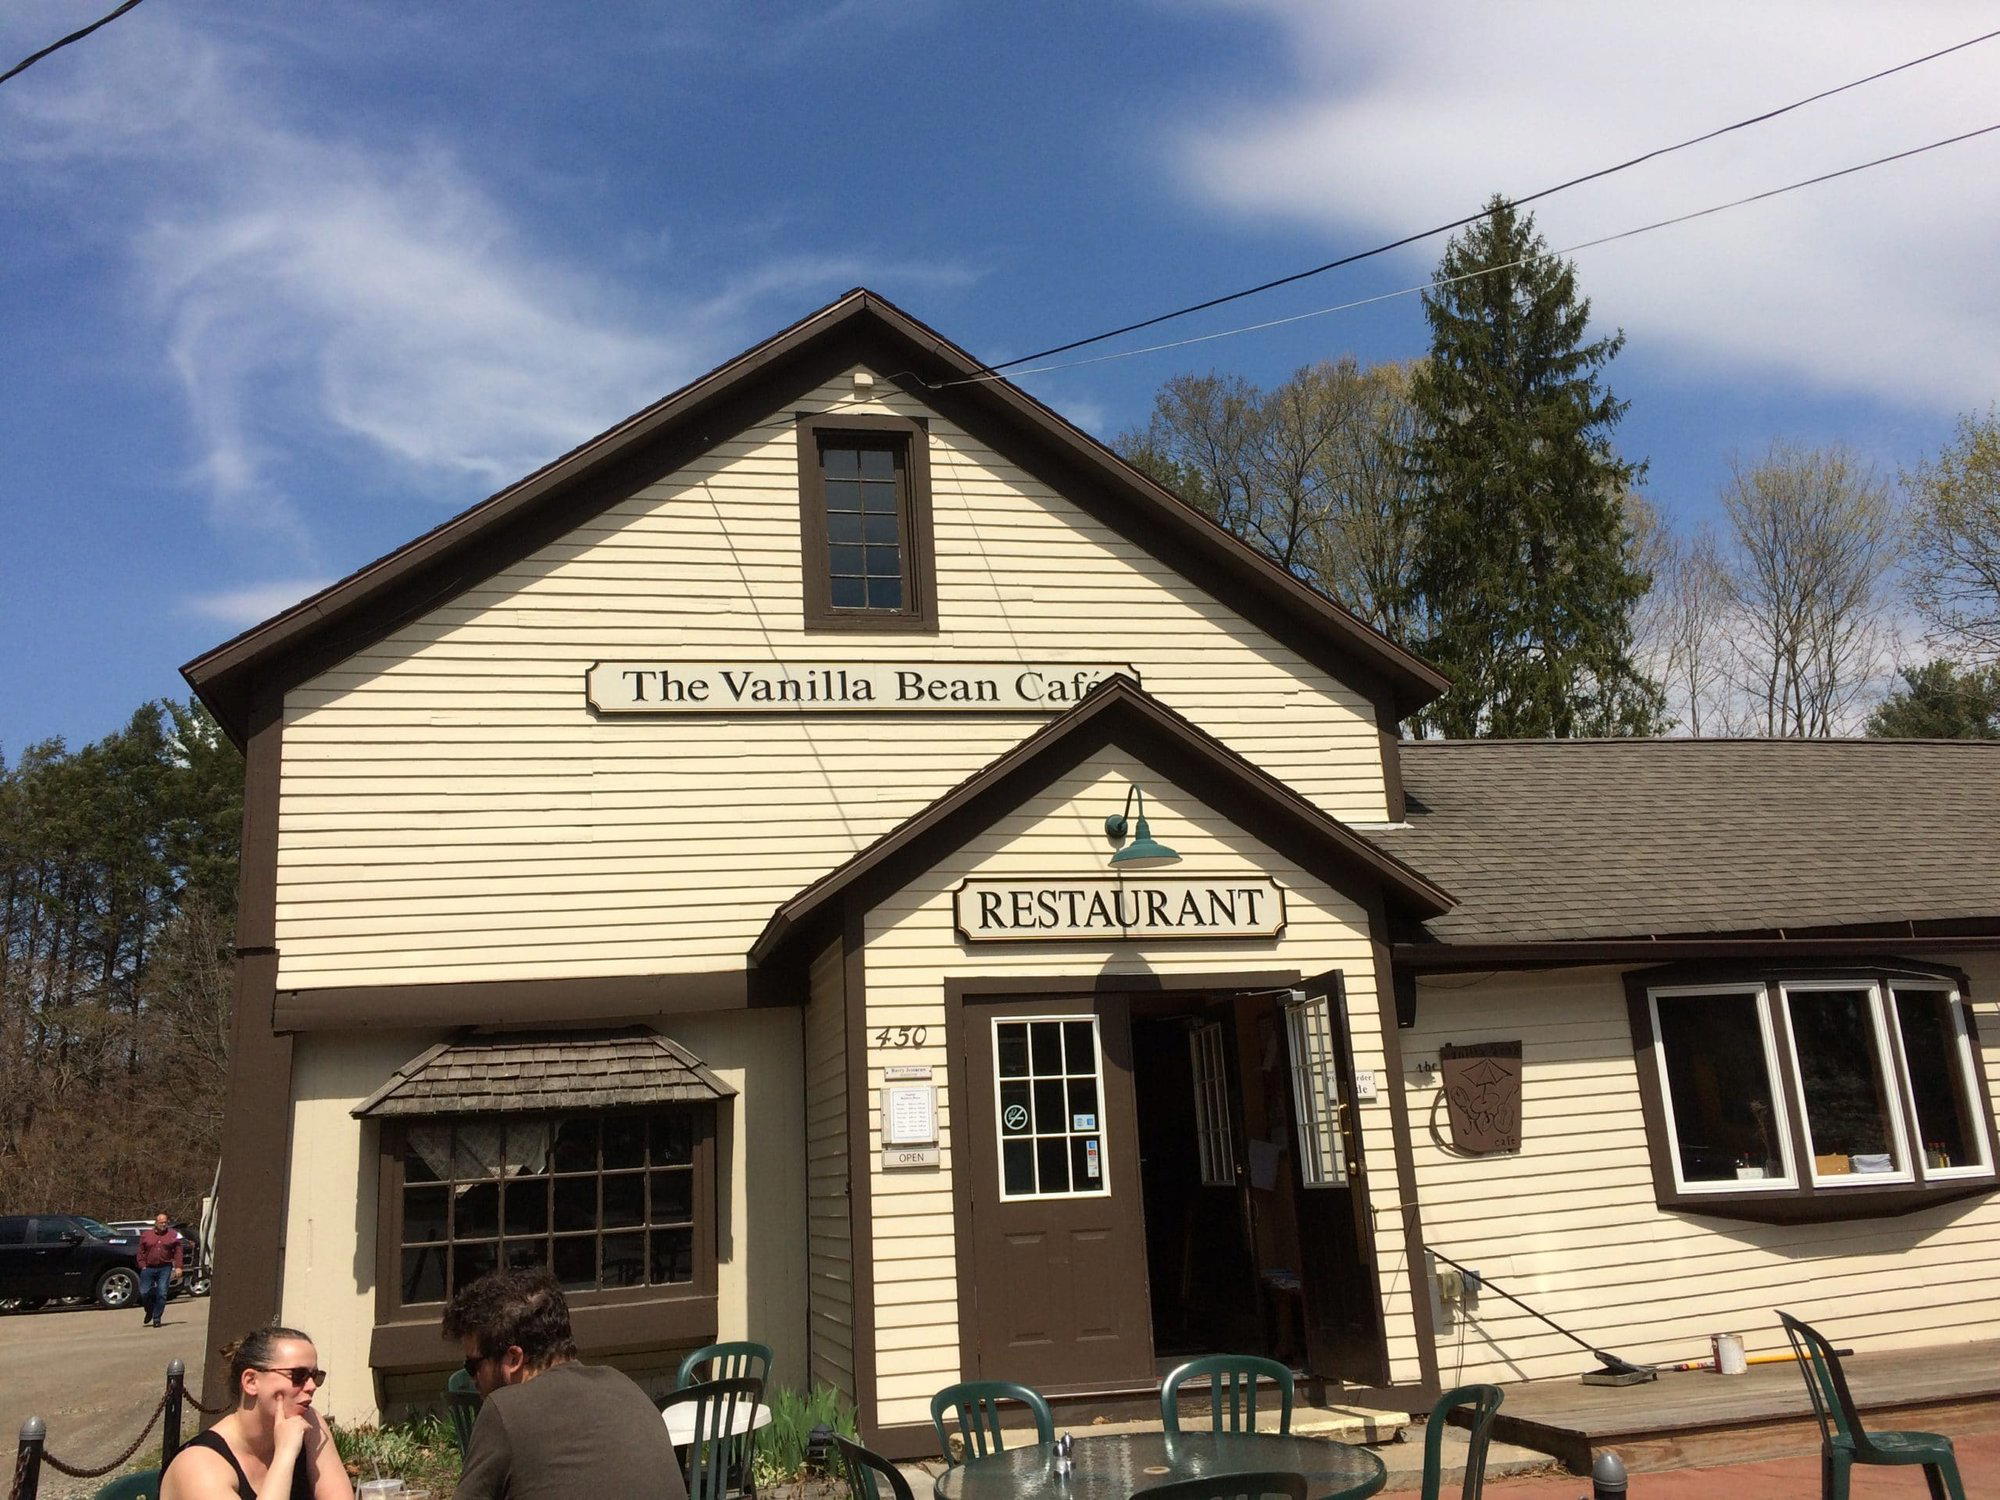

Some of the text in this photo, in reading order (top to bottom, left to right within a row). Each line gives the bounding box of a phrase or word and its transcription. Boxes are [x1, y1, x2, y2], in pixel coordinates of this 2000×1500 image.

[622, 670, 709, 703] The
[718, 670, 876, 703] Vanilla
[894, 671, 1002, 703] Bean
[977, 888, 1264, 930] RESTAURANT
[876, 1026, 928, 1050] 450
[899, 1153, 925, 1164] OPEN
